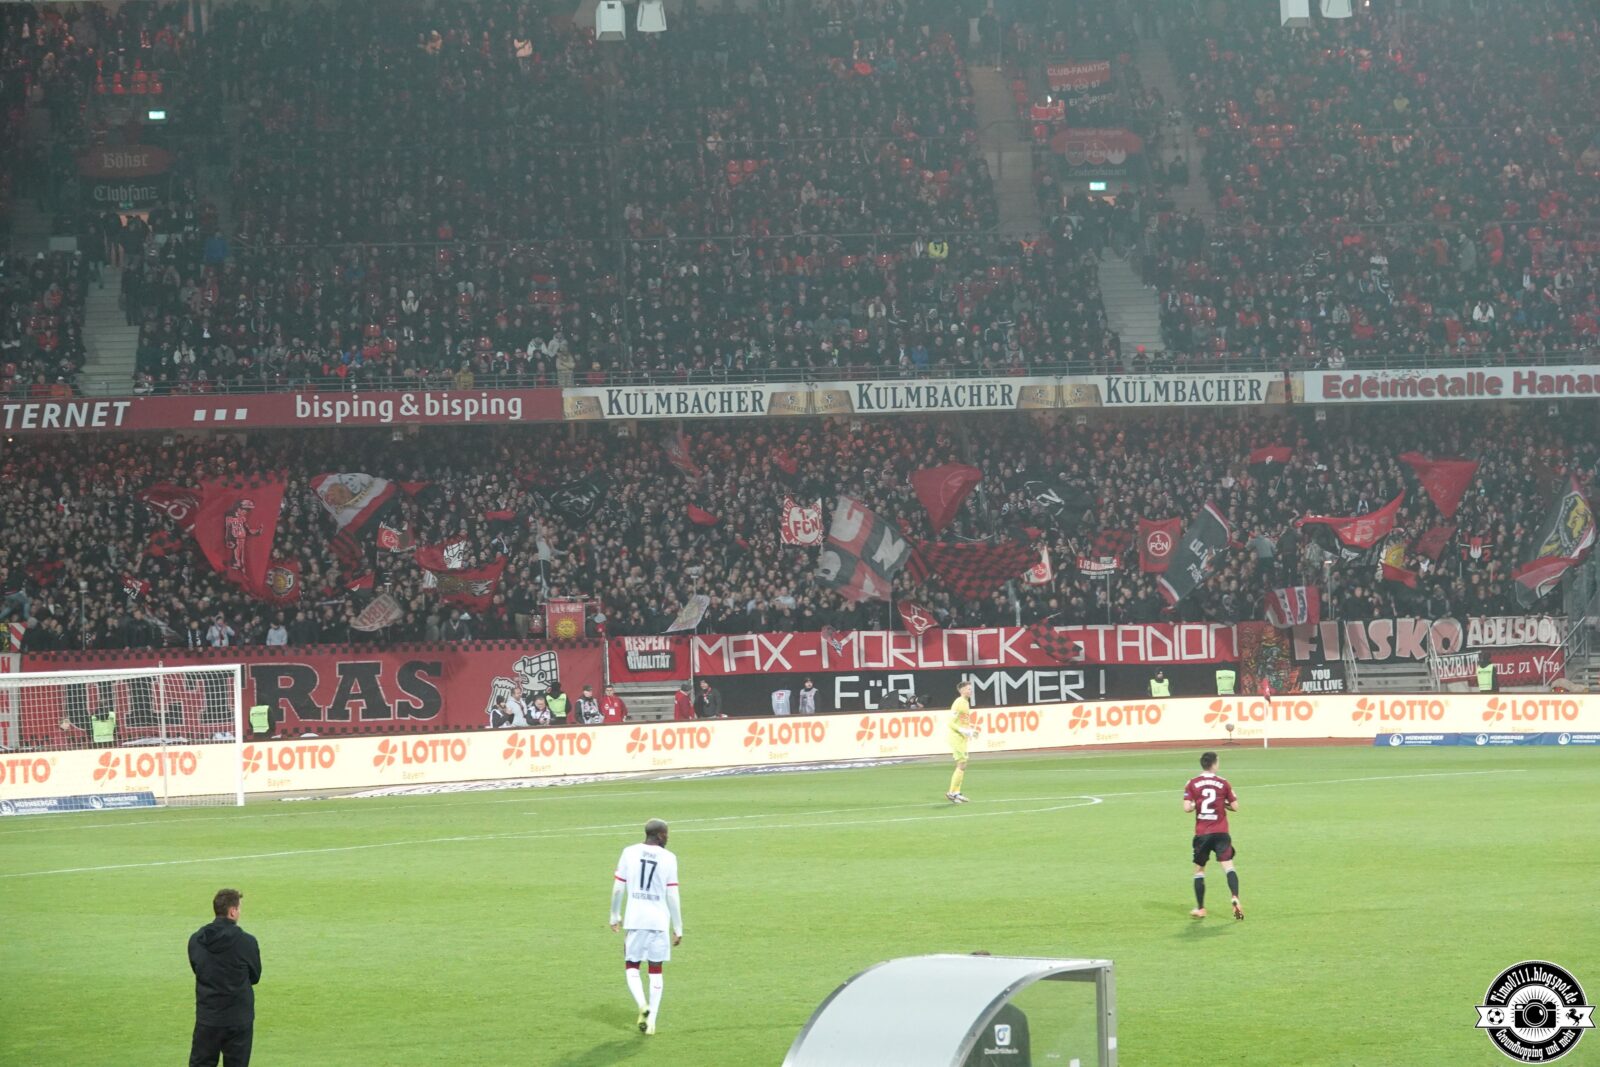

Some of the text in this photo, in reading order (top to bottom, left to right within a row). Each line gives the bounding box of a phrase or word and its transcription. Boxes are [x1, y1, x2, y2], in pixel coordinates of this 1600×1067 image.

[856, 382, 1015, 410] KULMBACHER
[1105, 376, 1263, 404] KULMBACHER
[1322, 372, 1503, 399] Edelmetalle
[296, 392, 522, 423] bisping & bisping
[606, 388, 765, 416] KULMBACHER
[3, 401, 131, 429] TERNET
[1150, 541, 1169, 551] FCN
[624, 636, 671, 650] RESPEKT
[1293, 617, 1463, 661] FIASKO
[626, 653, 671, 669] RIVALITÄT
[1311, 669, 1331, 680] YOU
[1323, 679, 1343, 690] LIVE
[987, 710, 1040, 734] LOTTO
[1096, 704, 1162, 728] LOTTO
[1238, 700, 1313, 722] LOTTO
[1379, 700, 1445, 721] LOTTO
[1511, 700, 1579, 721] LOTTO
[652, 726, 711, 751] LOTTO
[769, 721, 825, 745] LOTTO
[880, 716, 934, 740] LOTTO
[402, 738, 467, 764] LOTTO
[530, 732, 592, 757] LOTTO
[125, 751, 197, 778] LOTTO
[267, 745, 335, 771] LOTTO
[1200, 788, 1217, 814] 2
[640, 859, 658, 891] 17
